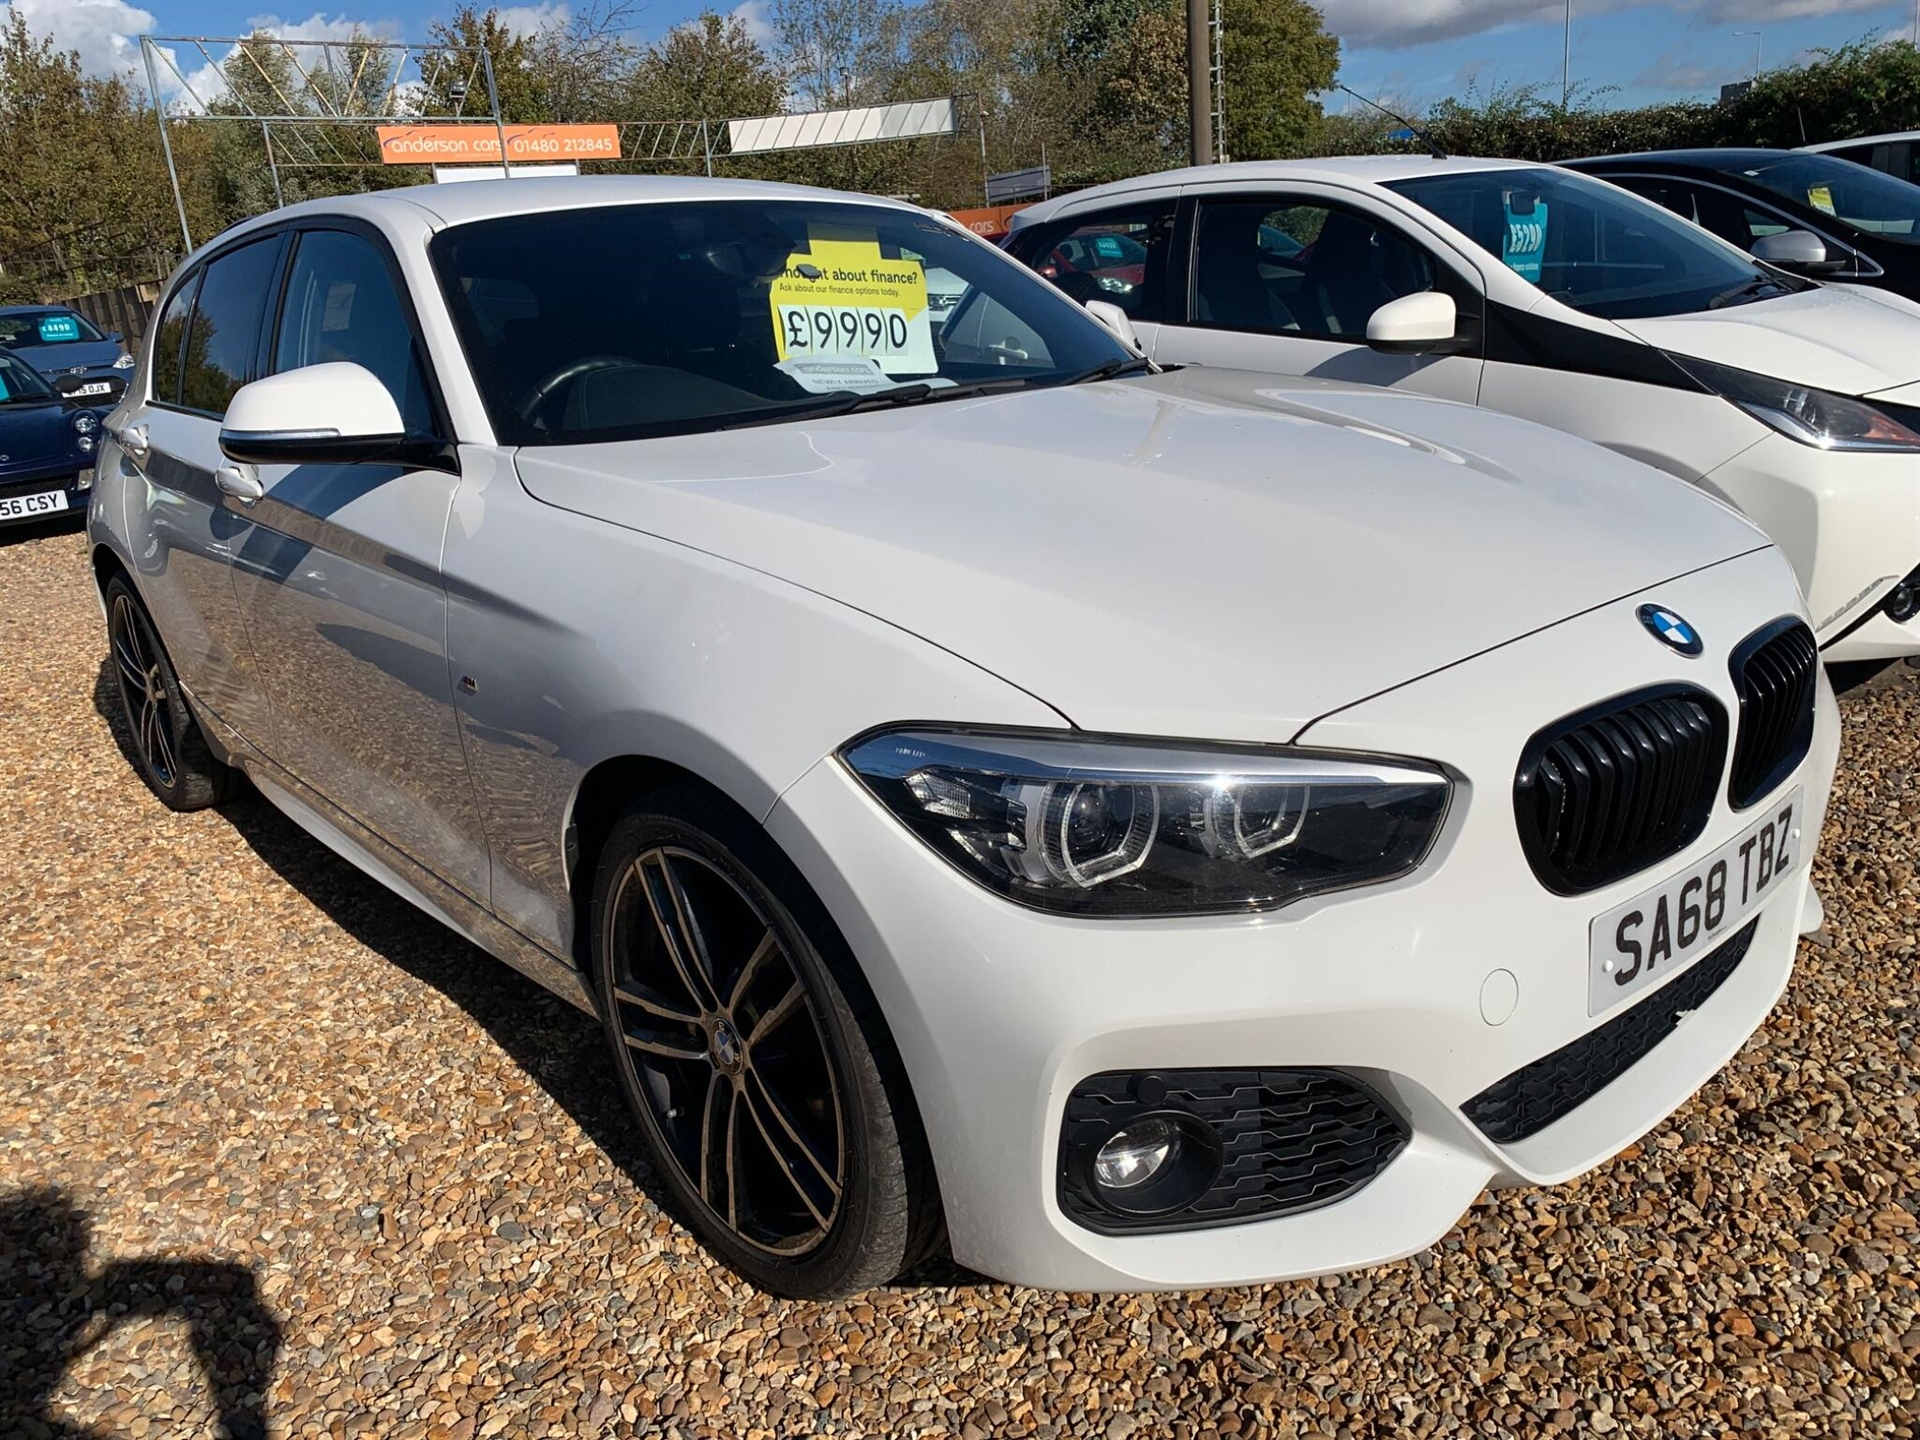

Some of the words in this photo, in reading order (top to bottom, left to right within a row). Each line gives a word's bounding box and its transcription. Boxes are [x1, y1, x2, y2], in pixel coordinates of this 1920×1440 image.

[392, 136, 469, 153] anderson
[473, 139, 502, 152] cars
[514, 139, 559, 153] 01480
[563, 138, 613, 152] 212845
[969, 221, 995, 234] cars
[1508, 223, 1542, 253] £5290
[832, 269, 867, 282] about
[871, 271, 918, 285] finance?
[779, 283, 792, 292] Ask
[794, 284, 815, 293] about
[829, 286, 854, 295] finance
[855, 288, 880, 296] options
[787, 310, 908, 349] £9990
[88, 384, 106, 393] OJX
[25, 493, 57, 512] CSY
[1614, 859, 1728, 986] SA68
[1738, 803, 1793, 906] TBZ
